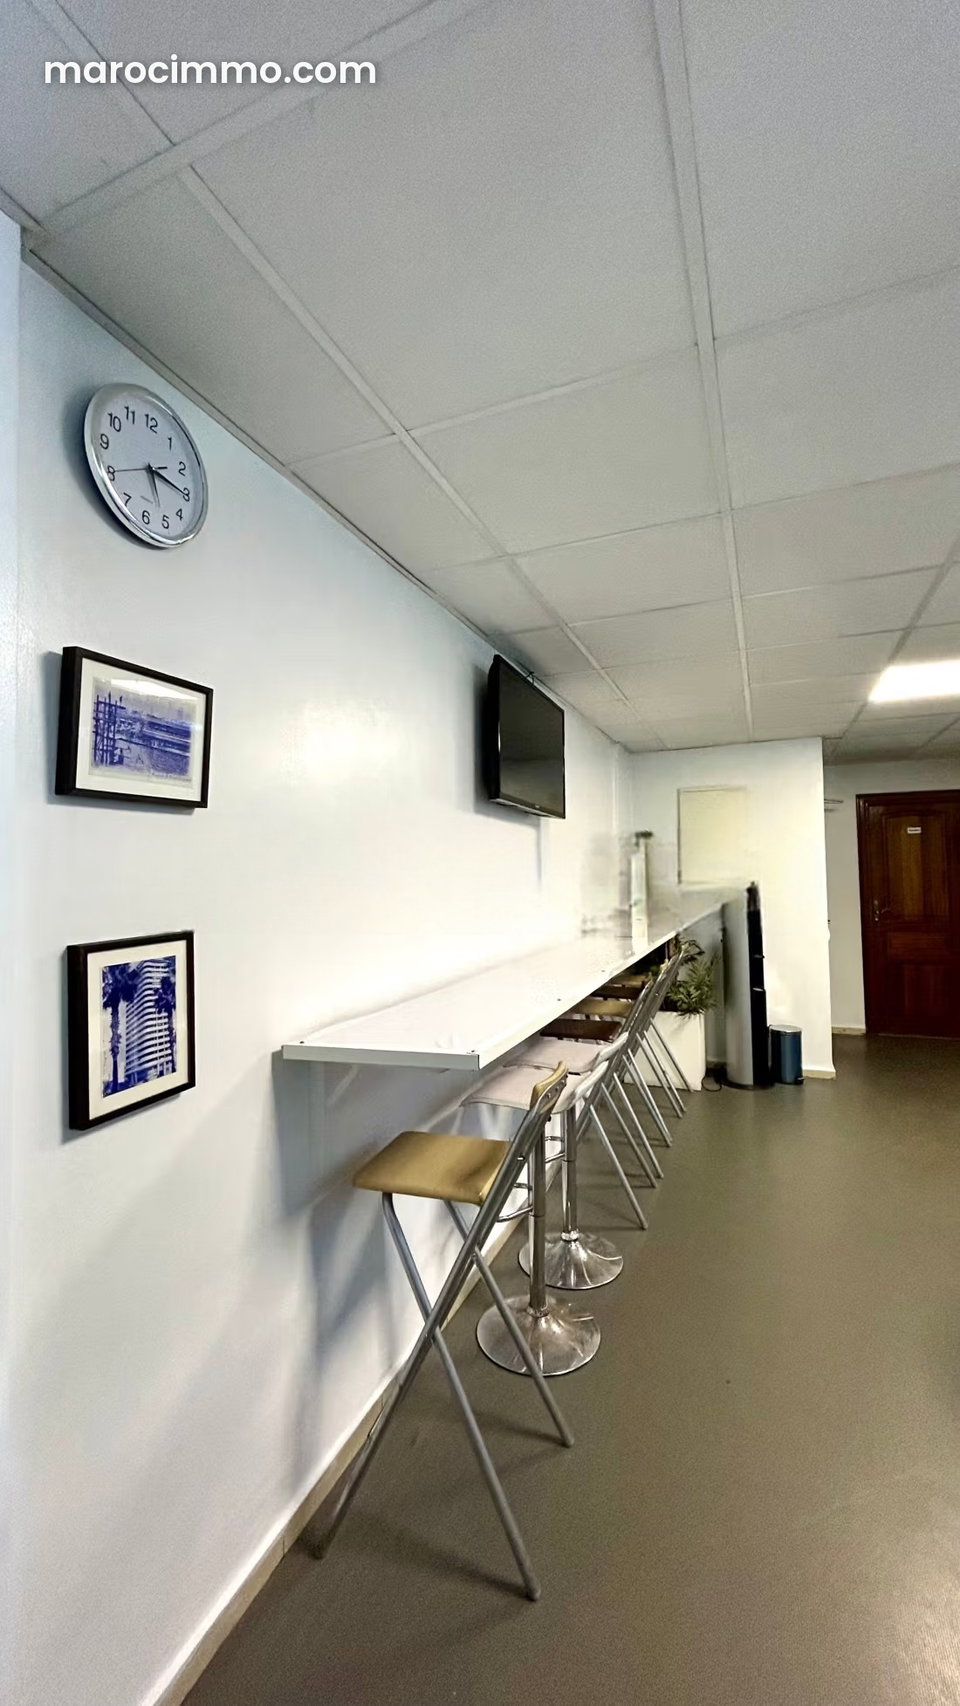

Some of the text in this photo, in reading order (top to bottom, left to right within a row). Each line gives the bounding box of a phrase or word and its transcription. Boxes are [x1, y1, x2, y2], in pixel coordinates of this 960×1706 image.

[108, 412, 122, 432] 10
[124, 406, 136, 425] 11
[144, 414, 159, 434] 12
[100, 434, 110, 450] 9
[167, 437, 173, 451] 1
[106, 465, 116, 482] 8
[178, 461, 187, 476] 2
[123, 492, 132, 507] 7
[182, 488, 191, 502] 3
[141, 510, 151, 525] 6
[161, 514, 170, 530] 5
[176, 508, 184, 521] 4
